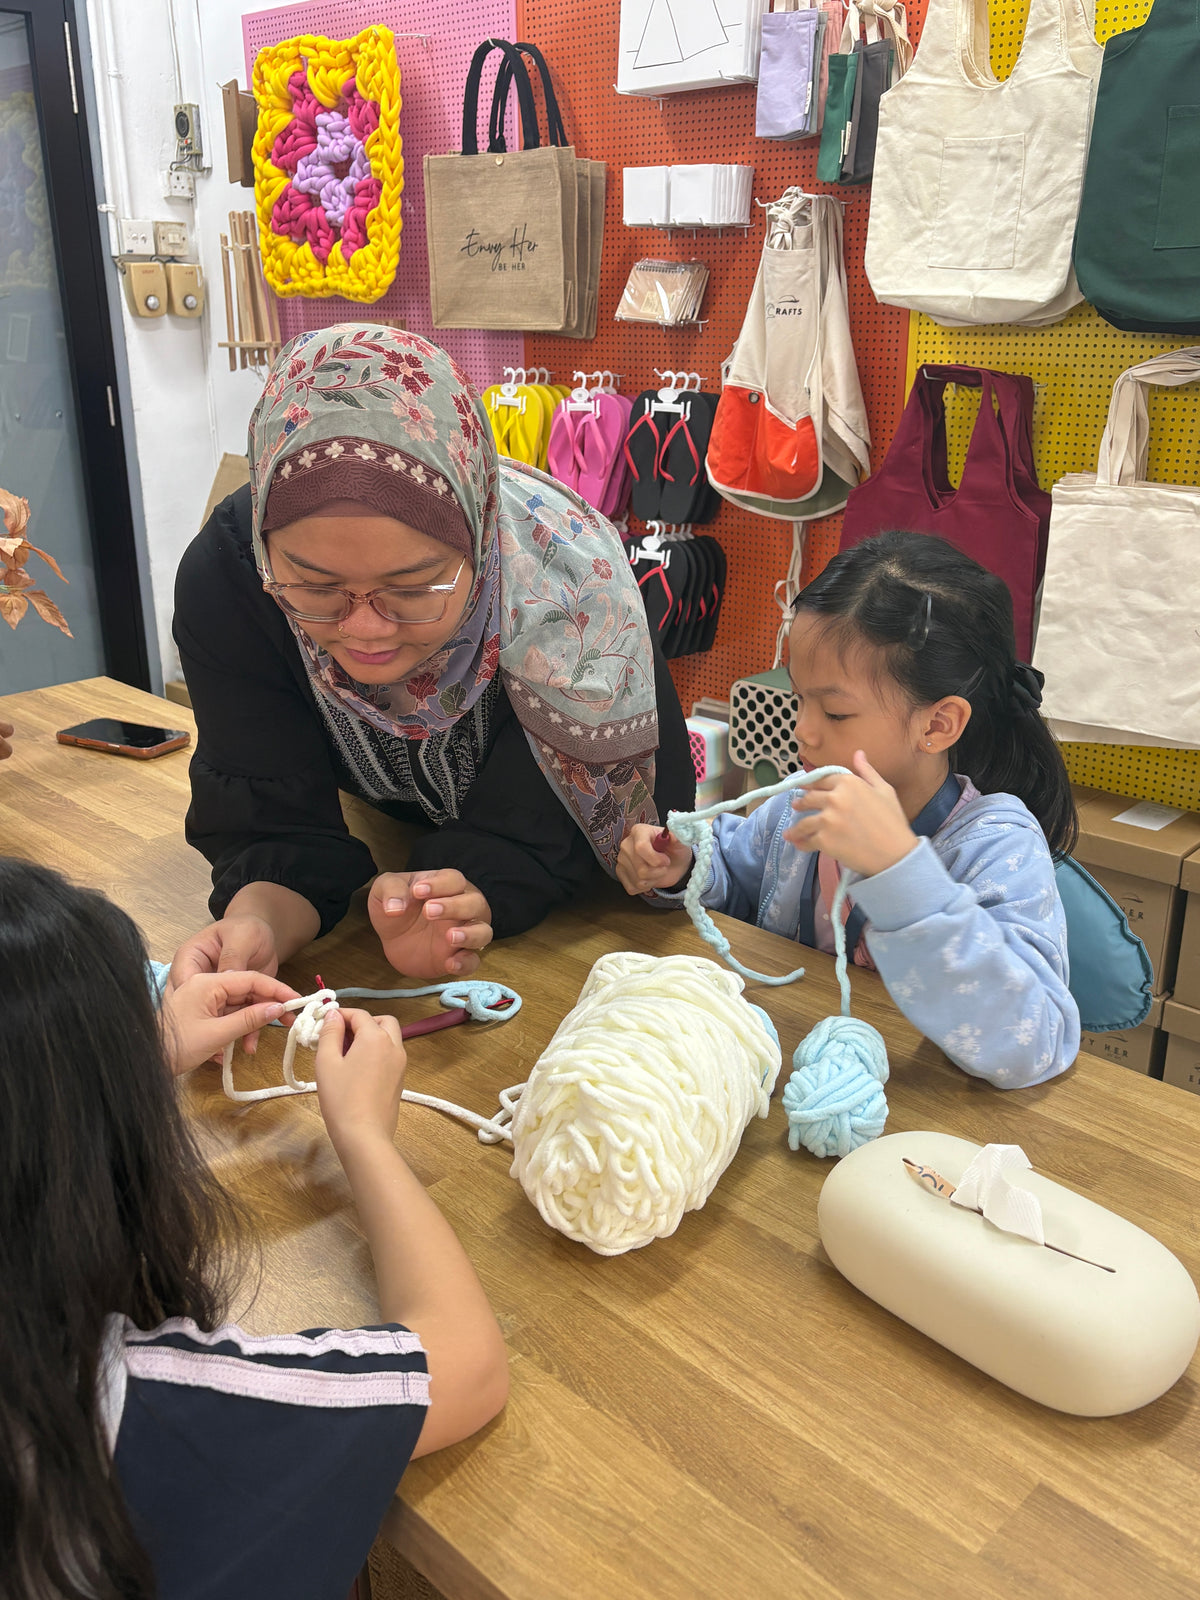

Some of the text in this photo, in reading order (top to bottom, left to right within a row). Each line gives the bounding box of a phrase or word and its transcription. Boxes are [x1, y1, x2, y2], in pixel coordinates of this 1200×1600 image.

[461, 222, 538, 272] Envy Her
[498, 262, 526, 271] BE HER
[1104, 1043, 1129, 1057] HER
